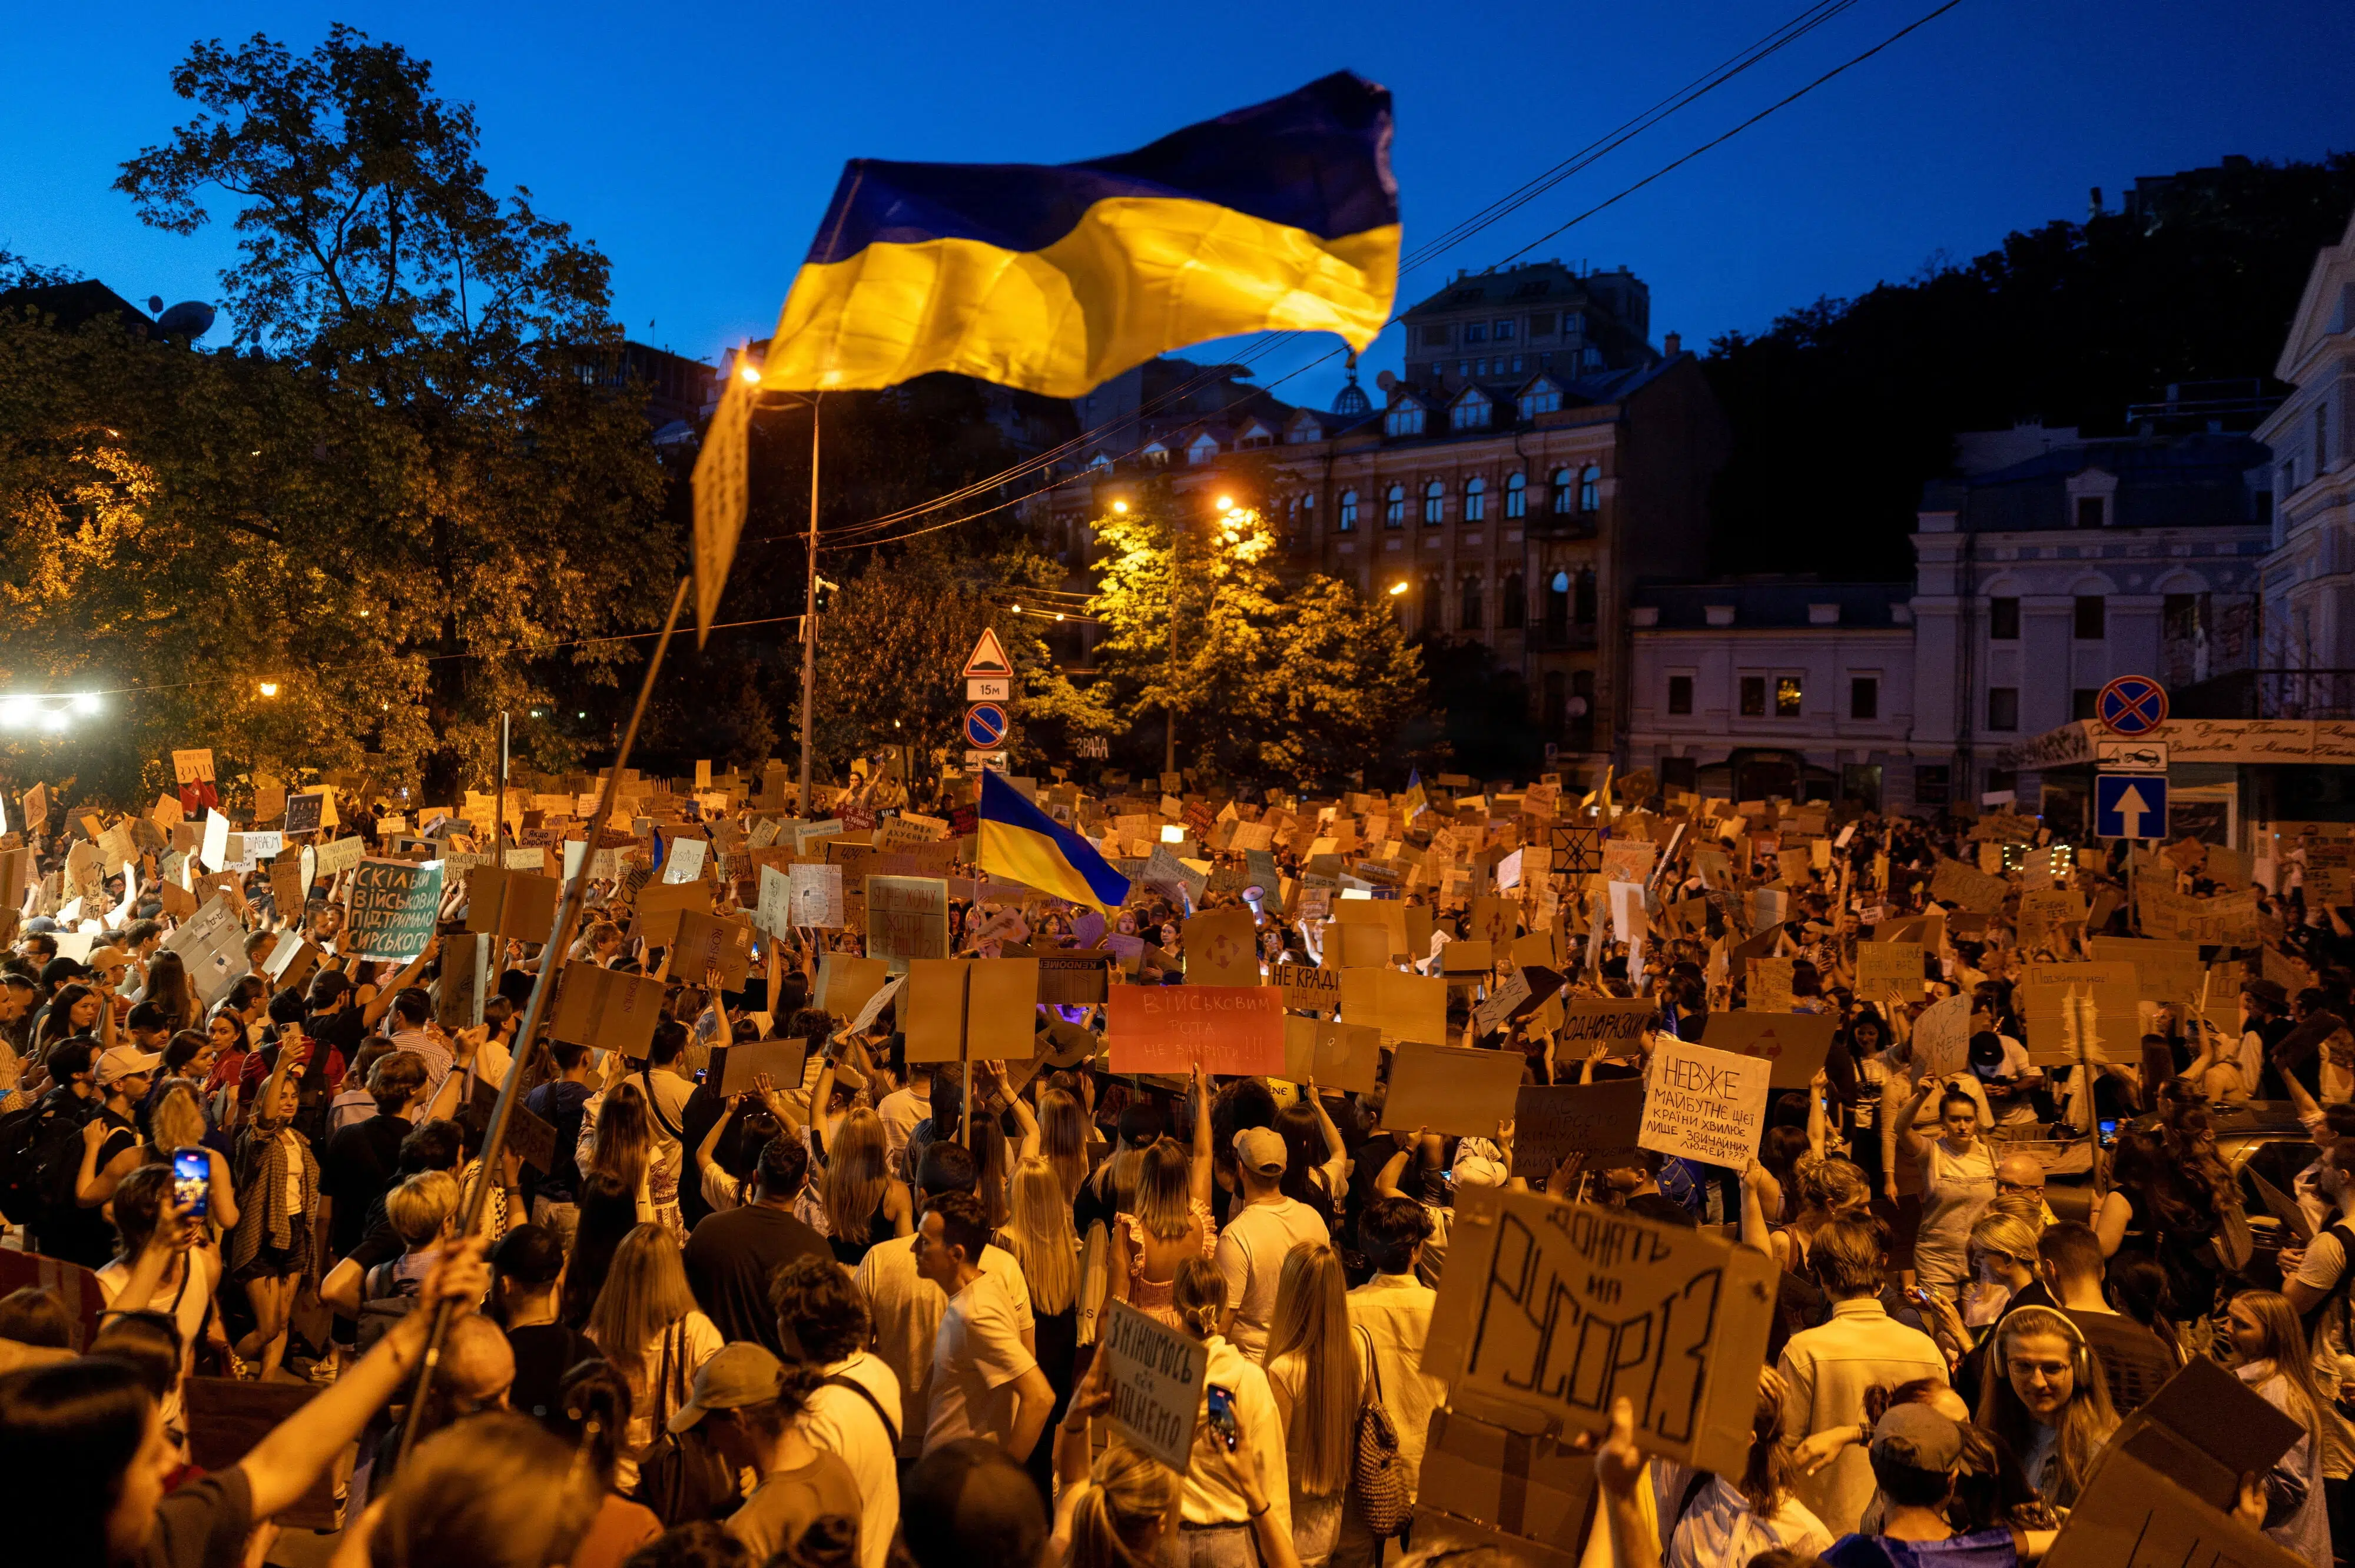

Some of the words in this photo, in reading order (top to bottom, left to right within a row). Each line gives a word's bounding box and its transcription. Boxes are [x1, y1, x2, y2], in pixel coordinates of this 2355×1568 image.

[1076, 736, 1108, 759] ЗРАДА
[857, 809, 864, 817] ЗА
[529, 830, 549, 839] Якщо
[887, 829, 929, 842] АХУЄННА
[356, 866, 429, 889] СКІЛЬКИ
[354, 889, 440, 910] ВІЙСЬКОВИХ
[873, 886, 881, 905] Я
[887, 887, 900, 906] НЕ
[905, 888, 936, 909] ХОЧУ
[350, 909, 434, 929] ПІДТРИМАЛО
[349, 929, 429, 952] СИРСЬКОГО
[706, 928, 723, 975] ROSHEN
[871, 934, 879, 952] В
[1272, 966, 1292, 986] НЕ
[623, 976, 641, 1013] ROSHEN
[1144, 991, 1271, 1014] ВІЙСЬКОВИМ
[1167, 1019, 1215, 1036] РОТА
[1144, 1044, 1166, 1057] НЕ
[1175, 1044, 1239, 1057] ЗАКРИТИ
[1664, 1055, 1741, 1101] НЕВЖЕ
[1654, 1088, 1729, 1121] МАЙБУТНЄ
[1732, 1107, 1754, 1127] ЦІЄЇ
[1653, 1108, 1699, 1128] КРАЇНИ
[1701, 1121, 1746, 1137] ХВИЛЮЄ
[1646, 1121, 1679, 1135] ЛИШЕ
[1686, 1130, 1750, 1154] ЗВИЧАЙНИХ
[1585, 1275, 1622, 1305] НА
[1468, 1211, 1723, 1444] РУСОРІЗ
